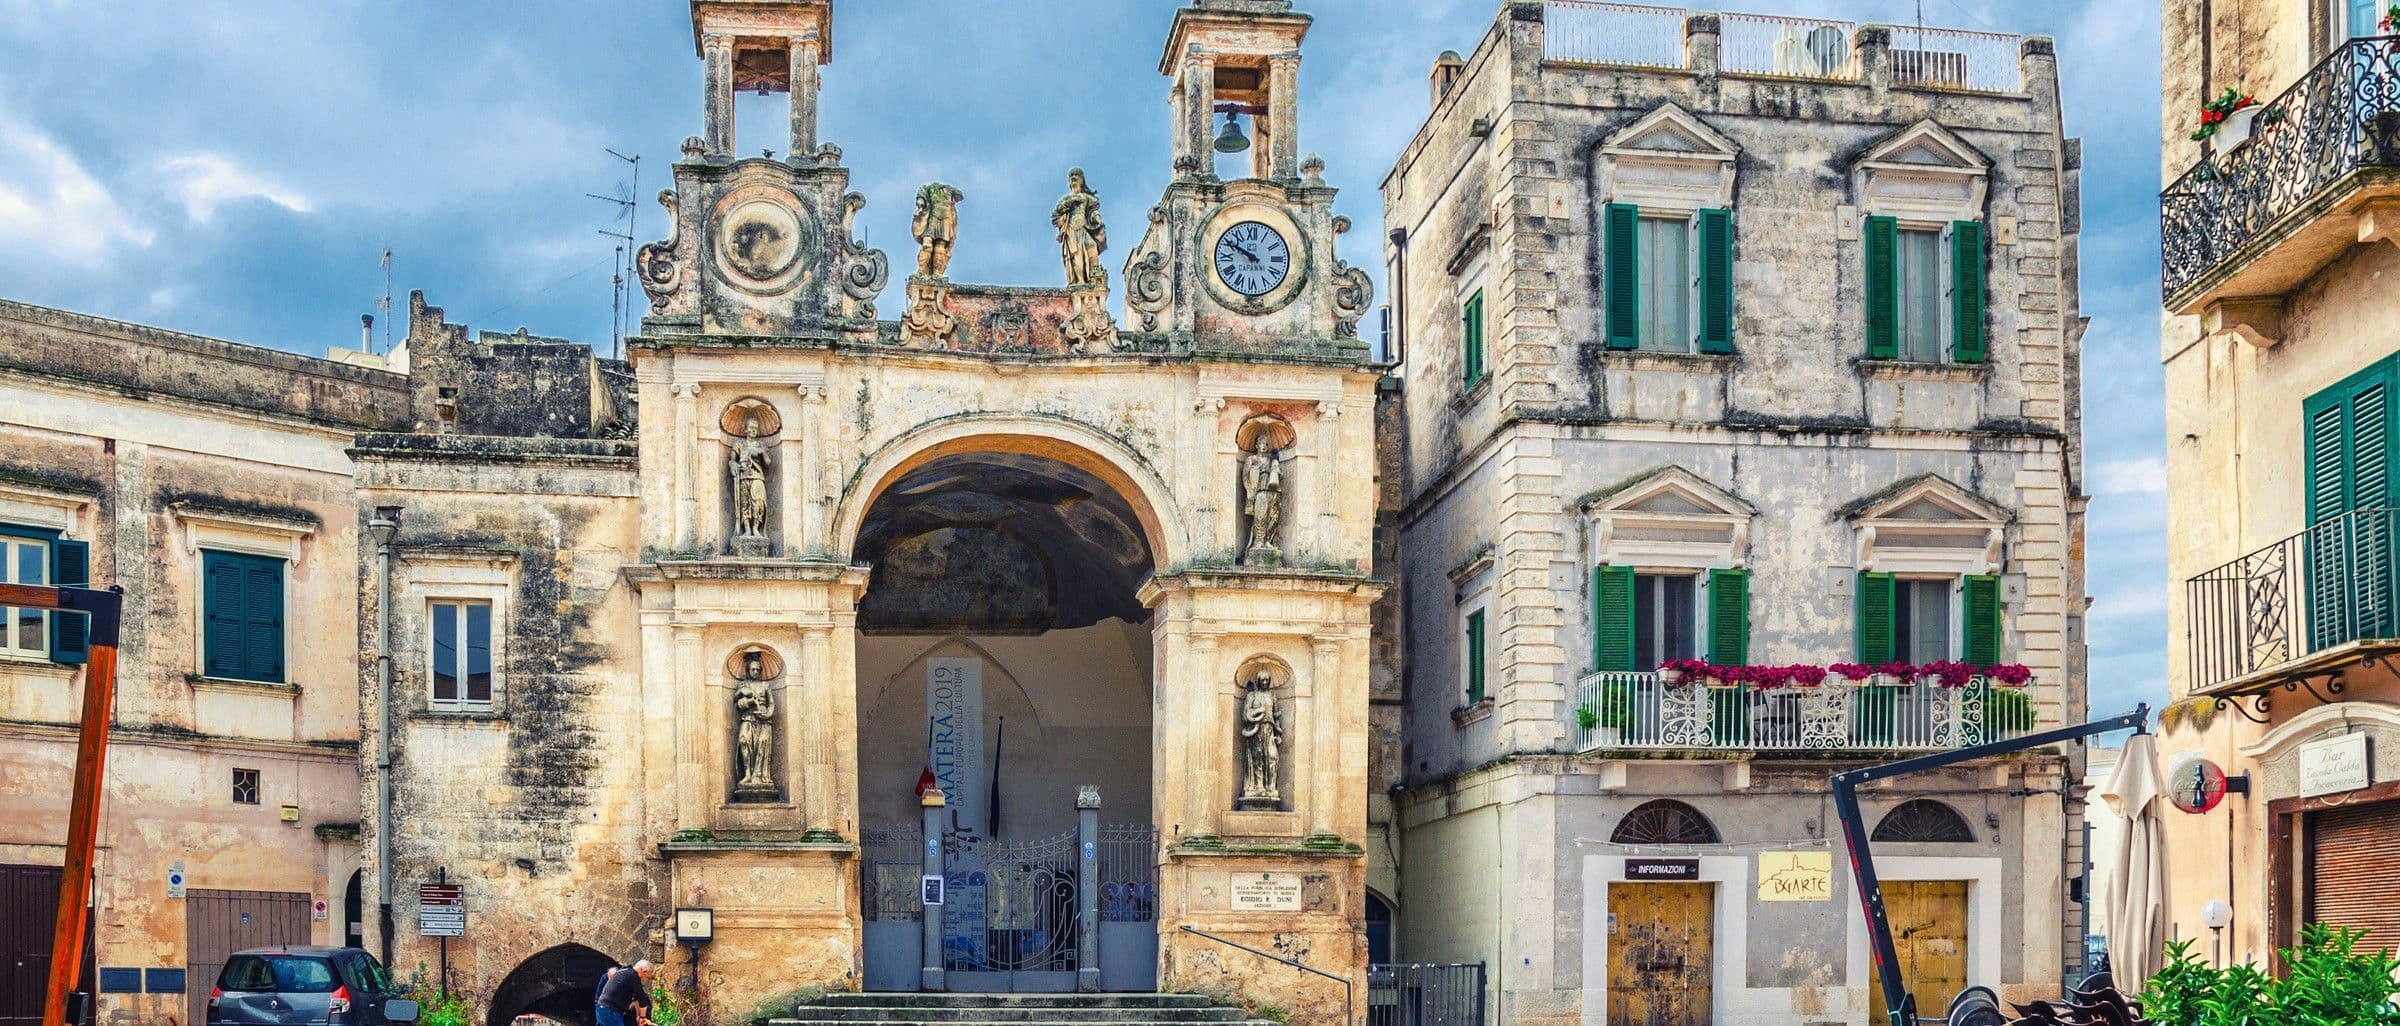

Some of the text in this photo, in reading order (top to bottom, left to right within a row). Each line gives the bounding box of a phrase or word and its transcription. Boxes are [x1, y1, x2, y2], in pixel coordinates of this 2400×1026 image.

[1246, 227, 1258, 241] XII
[1260, 231, 1269, 244] I
[1267, 241, 1281, 252] II
[954, 705, 963, 730] DELLA
[934, 666, 955, 805] MATERA 2019
[2319, 747, 2346, 764] Bar
[1638, 865, 1686, 874] INFORMAZIONI
